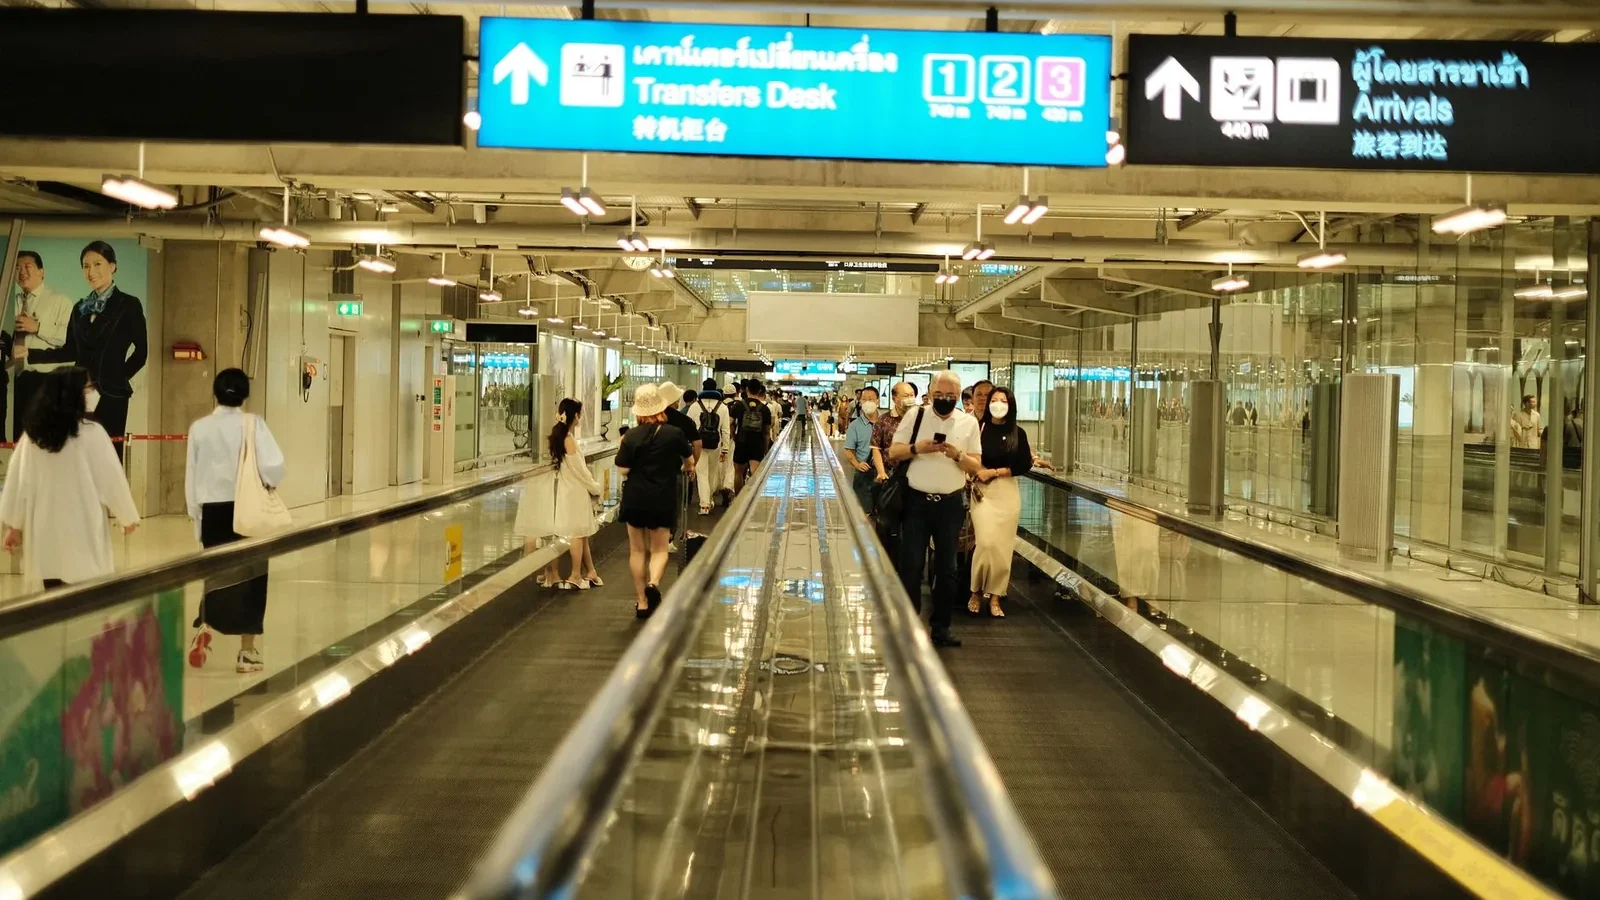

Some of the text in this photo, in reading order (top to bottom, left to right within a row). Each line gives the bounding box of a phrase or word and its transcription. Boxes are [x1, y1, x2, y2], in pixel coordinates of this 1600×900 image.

[938, 61, 956, 96] 1
[992, 62, 1018, 97] 2
[1048, 64, 1072, 98] 3
[1352, 48, 1529, 92] ผู้โดยสารขาเข้า
[633, 77, 837, 110] Transfers Desk
[1352, 93, 1454, 125] Arrivals
[633, 115, 728, 143] 转机柜台
[1221, 121, 1269, 140] 440 m
[1353, 129, 1448, 160] 旅客到达
